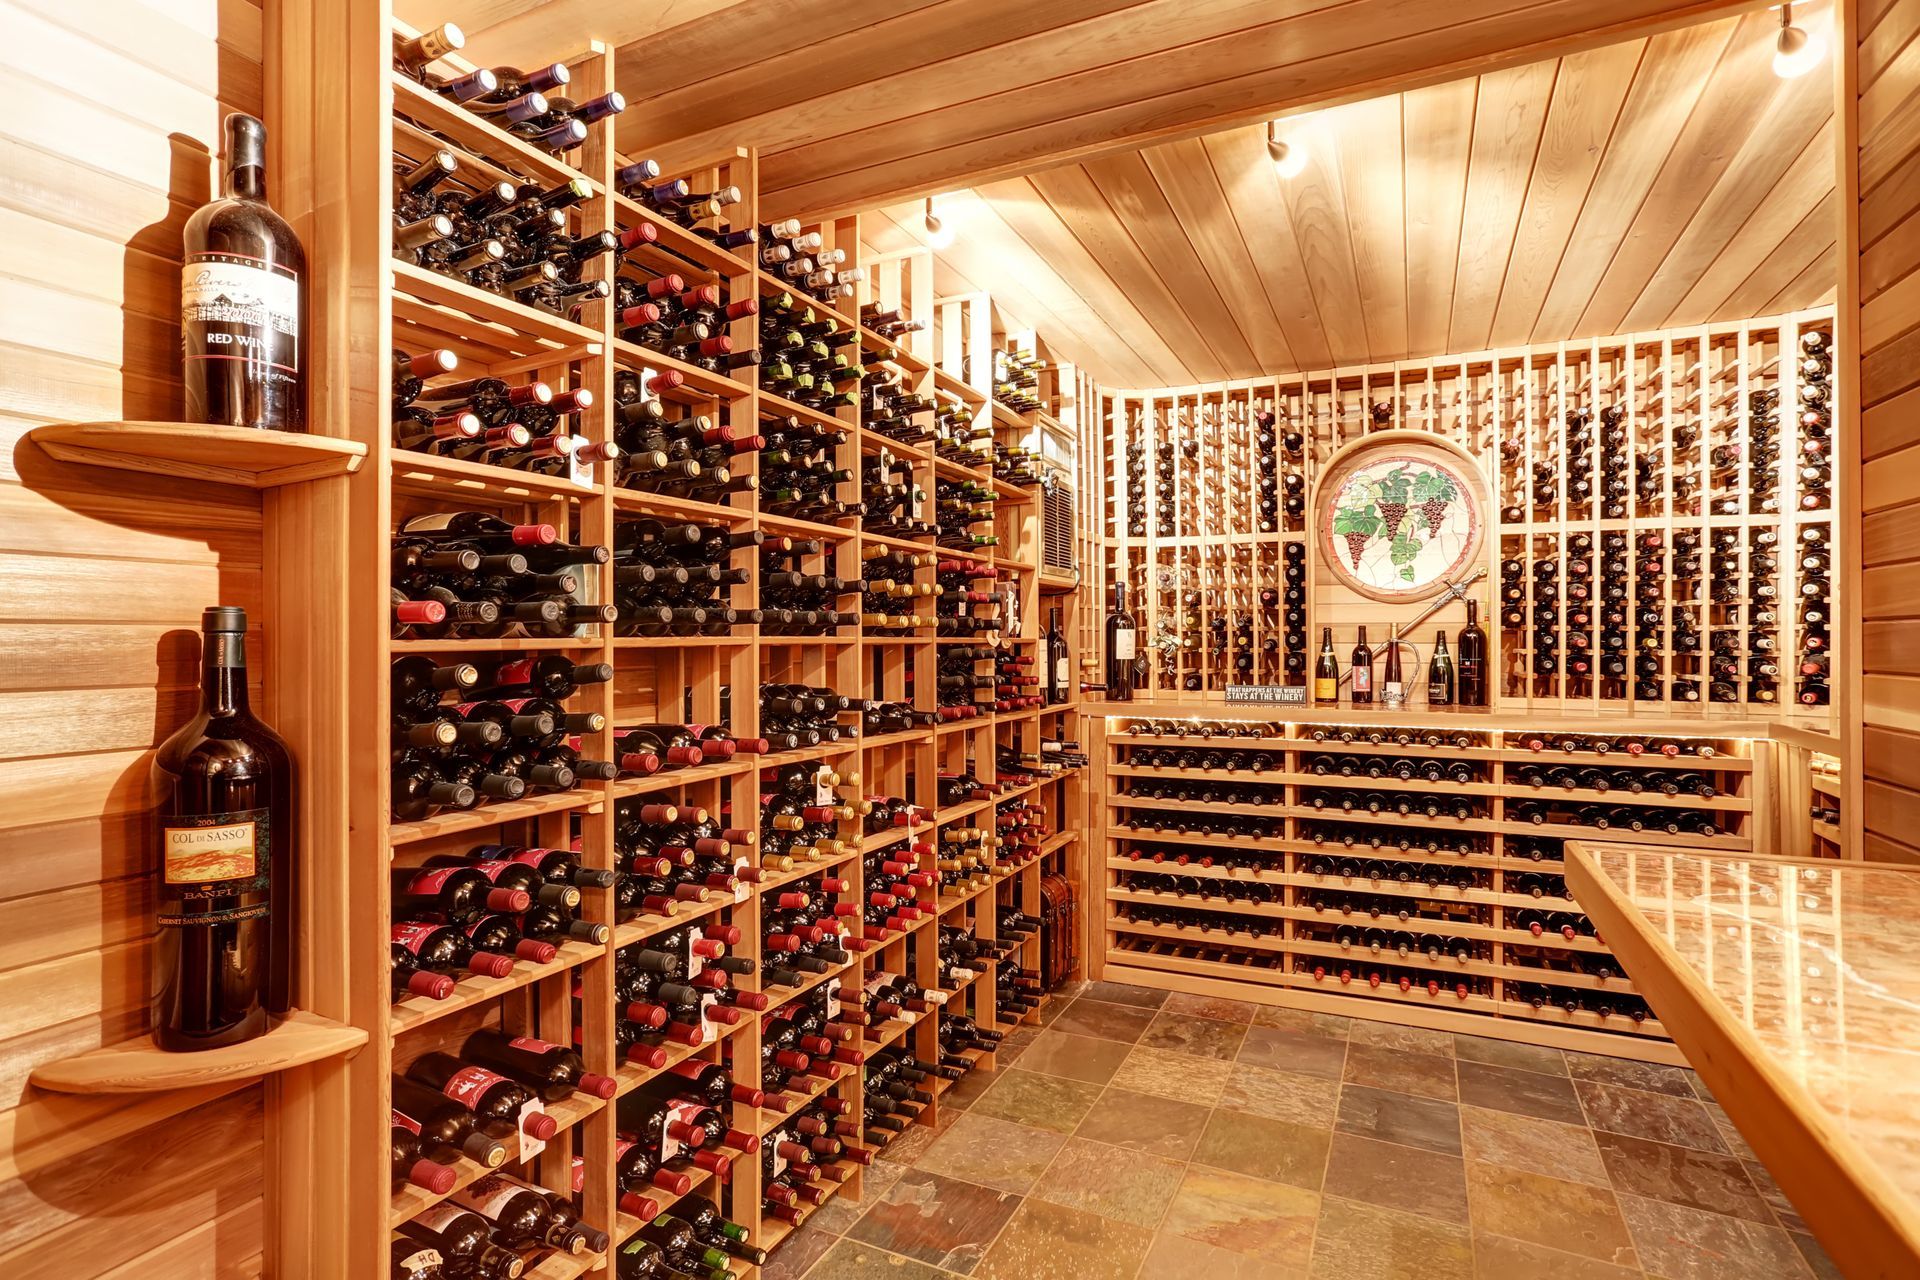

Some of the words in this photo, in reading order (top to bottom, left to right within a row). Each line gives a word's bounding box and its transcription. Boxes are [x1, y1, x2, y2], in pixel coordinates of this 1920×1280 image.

[207, 332, 233, 345] RED
[234, 334, 274, 352] WINE
[1259, 693, 1273, 701] THE
[197, 819, 216, 827] 2004
[172, 832, 195, 844] COL
[206, 828, 246, 842] SASSO
[183, 888, 233, 900] BANFI
[158, 916, 182, 925] CABERNET
[182, 915, 222, 925] SAUVIGNON
